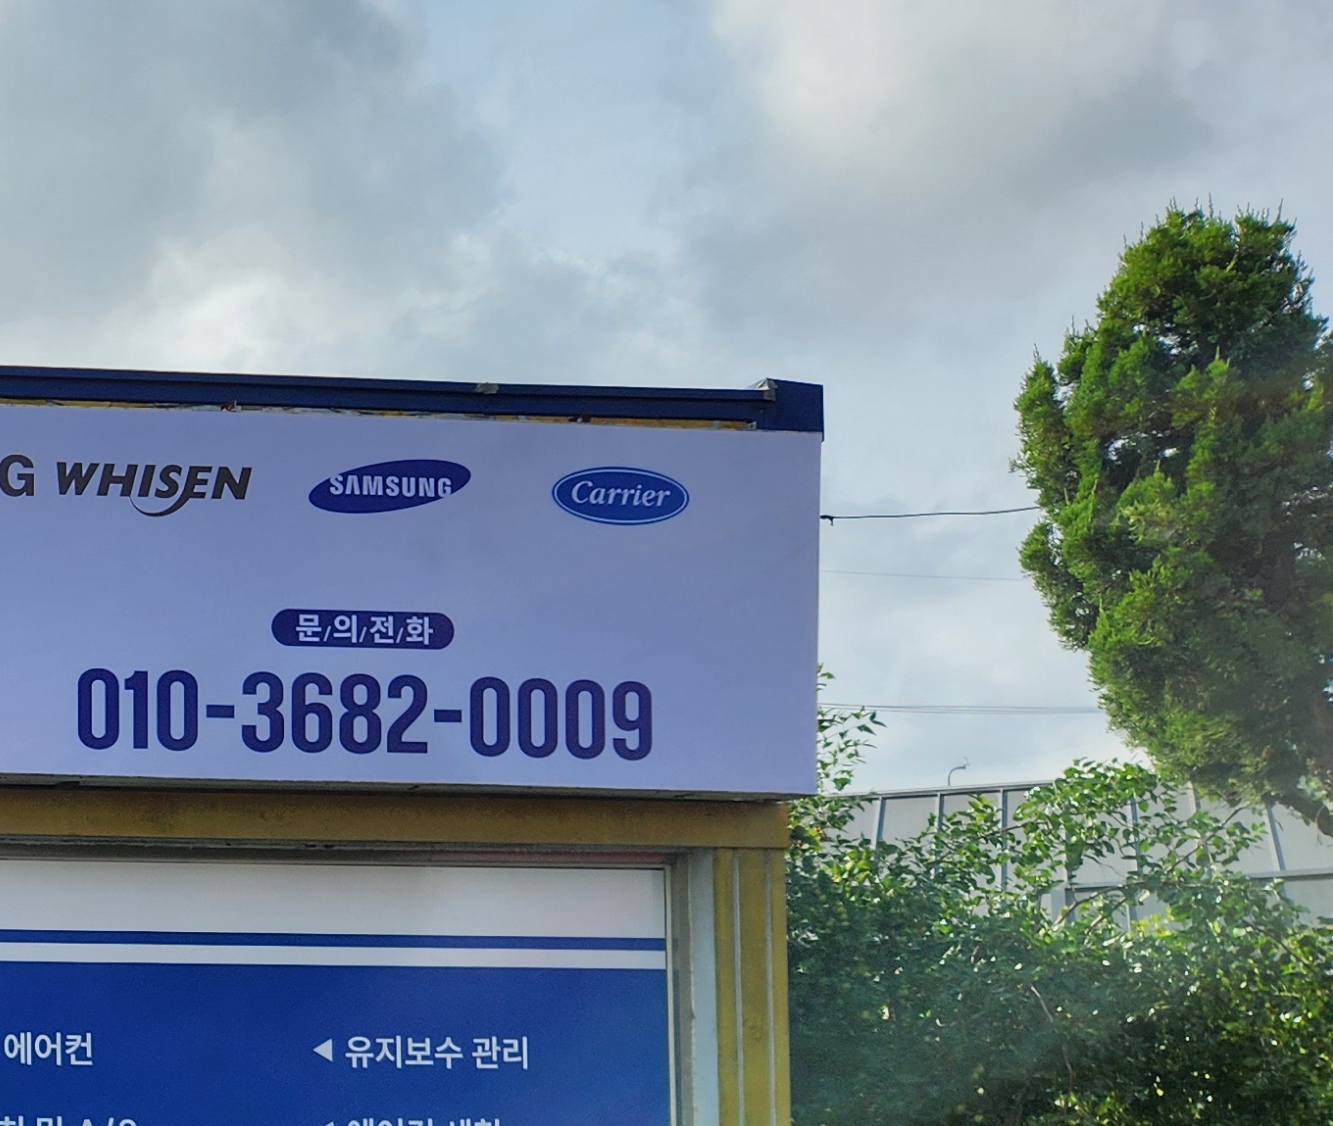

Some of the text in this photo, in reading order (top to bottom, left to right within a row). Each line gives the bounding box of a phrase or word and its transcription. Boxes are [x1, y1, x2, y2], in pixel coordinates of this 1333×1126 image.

[56, 461, 252, 517] WHISEN
[329, 474, 452, 498] SAMSUNG
[571, 480, 671, 507] Carrier
[77, 668, 653, 761] 010-3682-0009
[4, 1032, 93, 1066] 에어컨
[345, 1036, 529, 1070] 유지보수 관리
